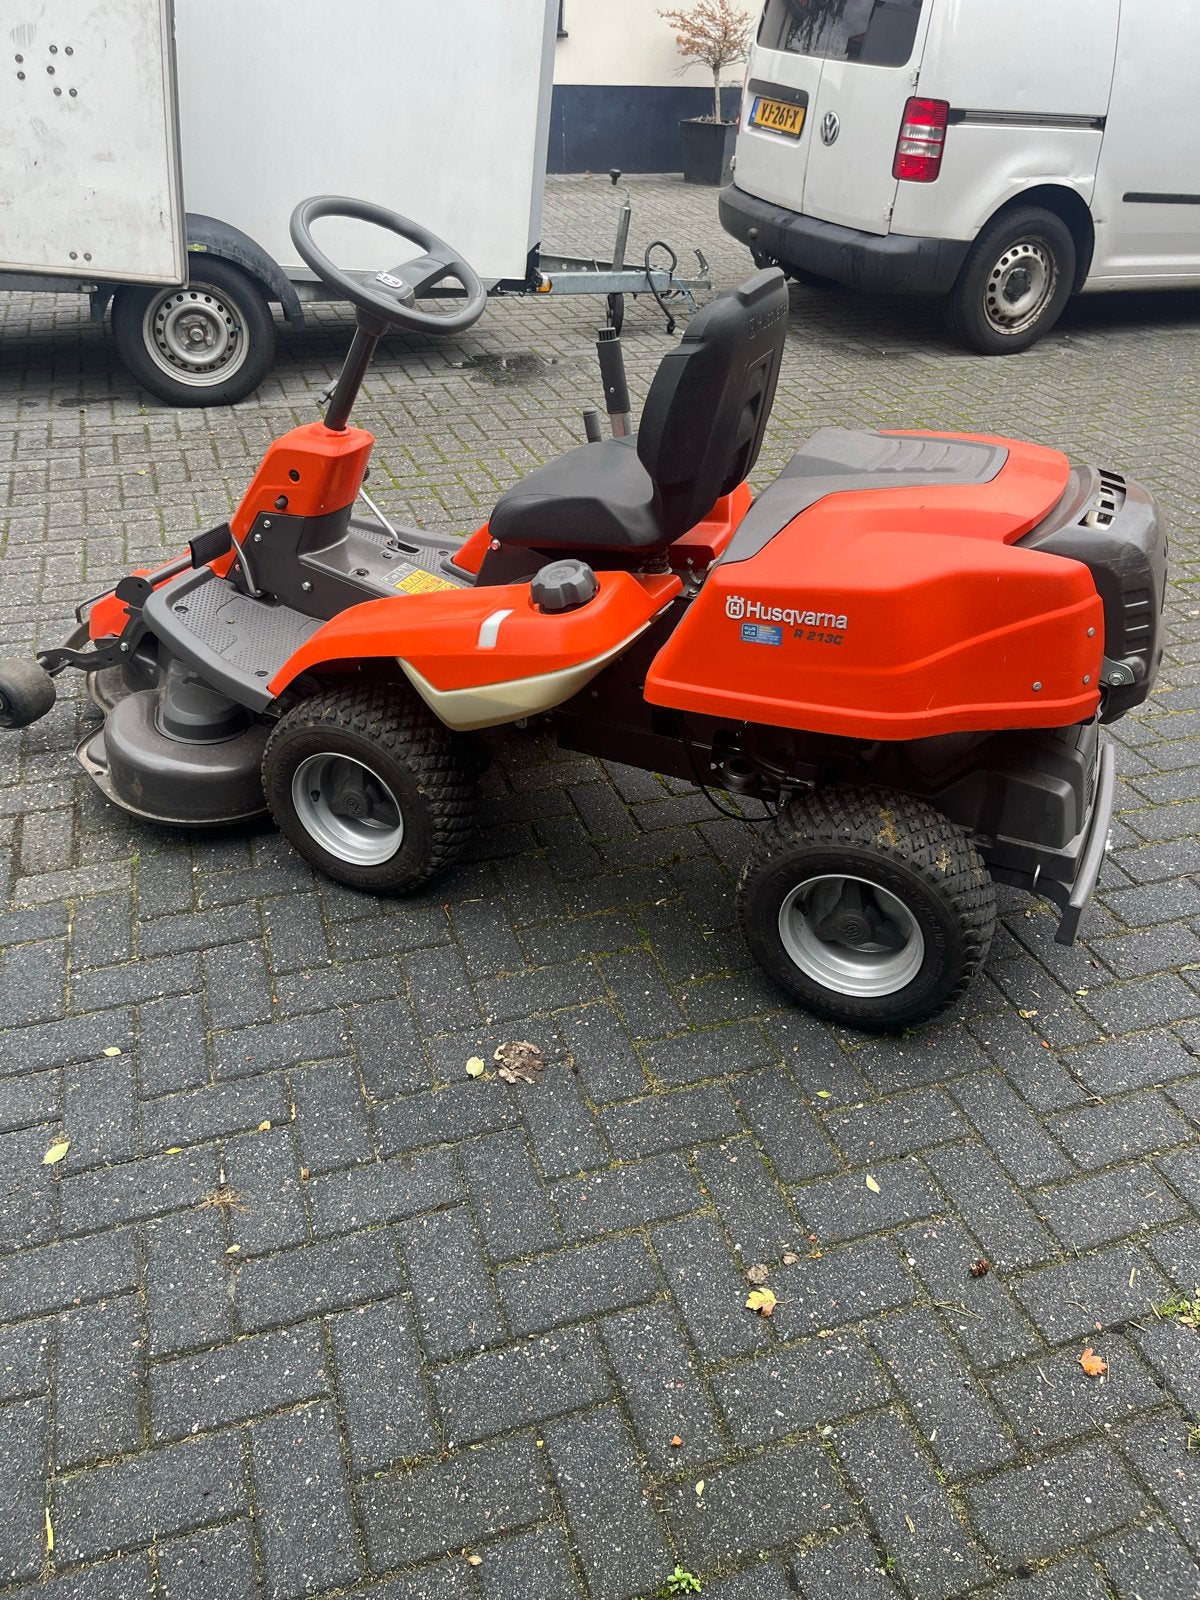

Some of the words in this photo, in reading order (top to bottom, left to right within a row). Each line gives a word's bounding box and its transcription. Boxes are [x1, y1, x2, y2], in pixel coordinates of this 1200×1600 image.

[761, 102, 799, 129] VJ-261-X
[746, 600, 848, 629] Husqvarna
[794, 629, 804, 639] R
[807, 632, 843, 645] 213C
